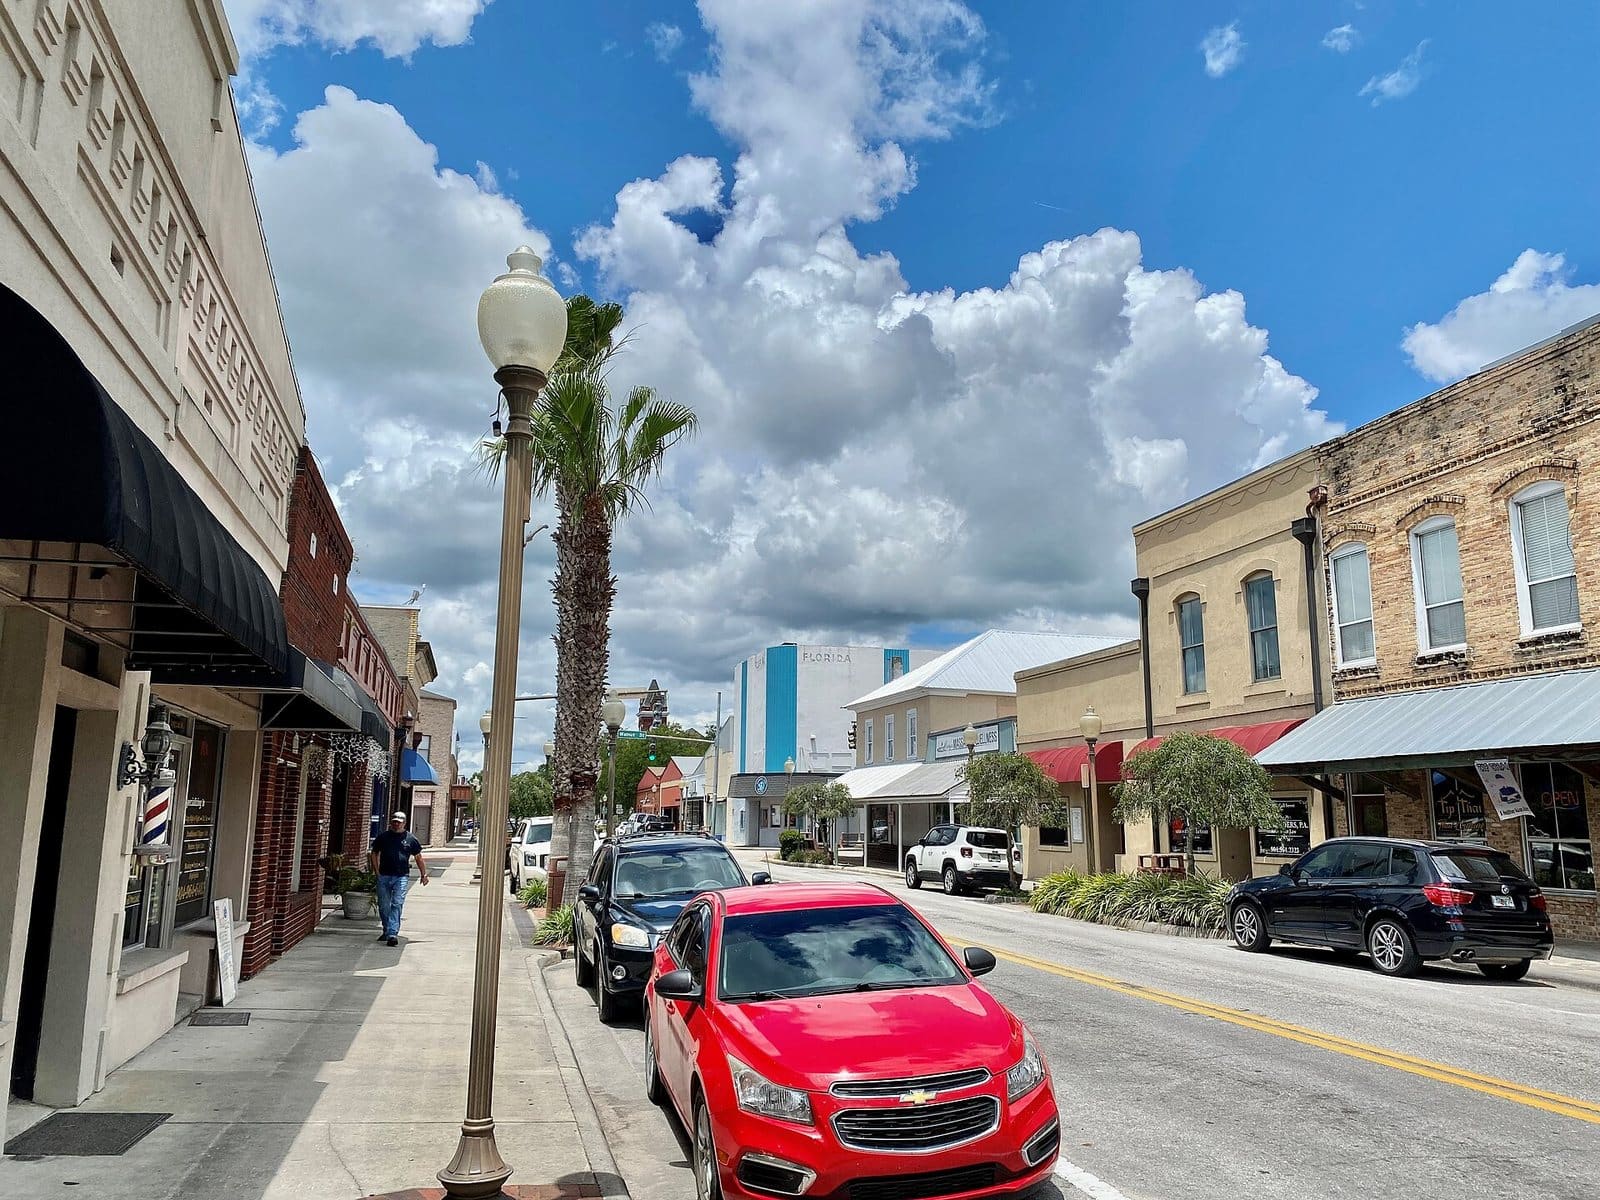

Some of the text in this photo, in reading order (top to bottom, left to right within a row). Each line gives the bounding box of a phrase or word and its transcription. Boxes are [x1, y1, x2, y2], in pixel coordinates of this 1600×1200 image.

[802, 652, 852, 663] FLORIDA
[1541, 790, 1580, 807] OPEN
[1437, 797, 1456, 819] Tip
[1457, 797, 1482, 814] Thai
